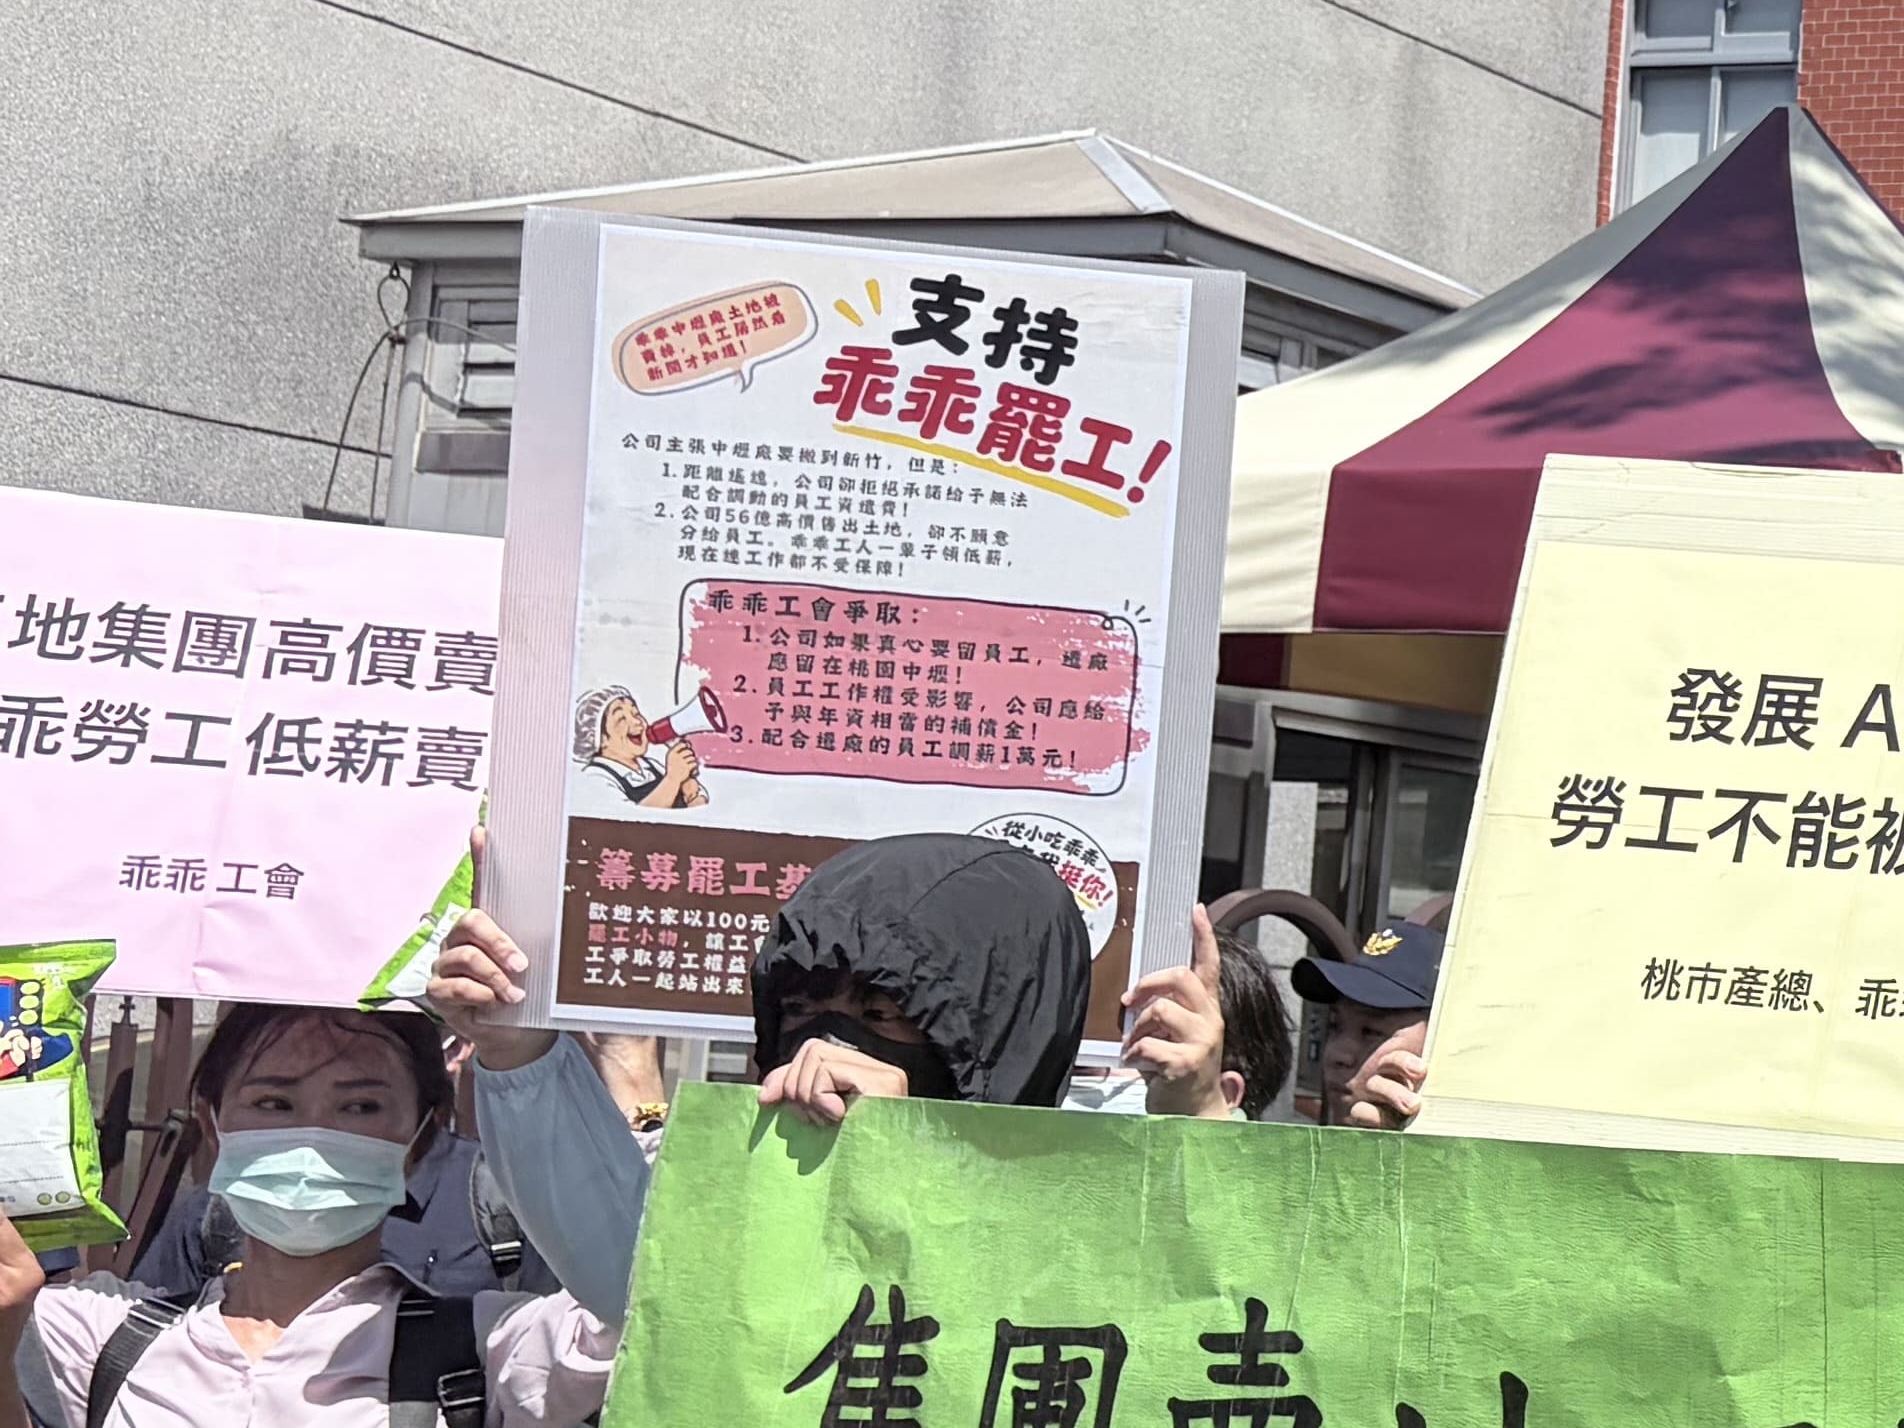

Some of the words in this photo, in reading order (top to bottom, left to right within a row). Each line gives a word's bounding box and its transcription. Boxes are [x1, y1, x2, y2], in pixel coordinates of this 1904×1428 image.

[891, 273, 1079, 386] 支持
[0, 593, 499, 697] 地集團高價賣
[1665, 665, 1818, 752] 發展
